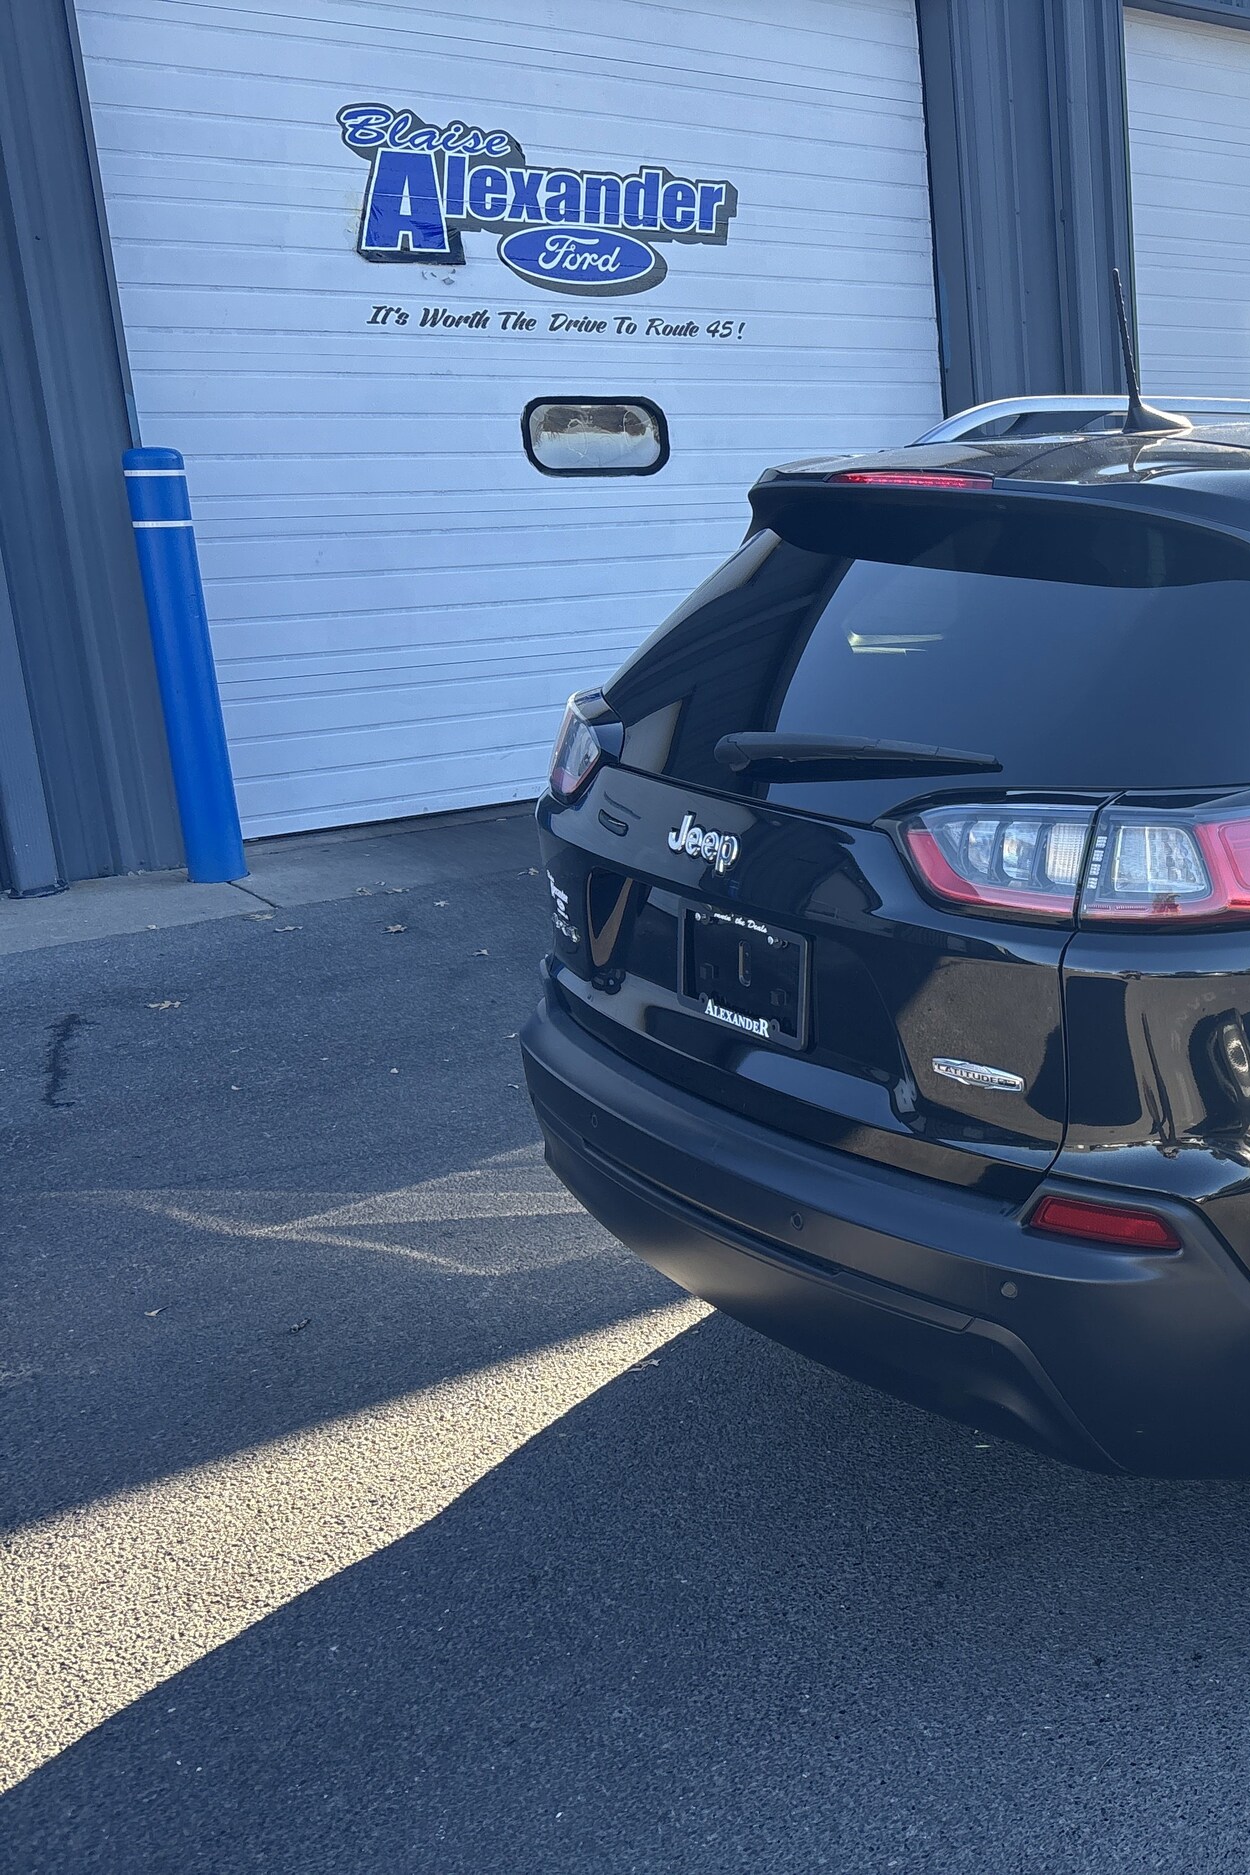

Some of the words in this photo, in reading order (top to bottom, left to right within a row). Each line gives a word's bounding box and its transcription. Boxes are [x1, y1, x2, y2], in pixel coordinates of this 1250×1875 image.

[341, 107, 512, 157] Blaise
[362, 147, 727, 253] Alexander
[538, 234, 621, 272] Ford
[366, 304, 410, 326] It's
[419, 307, 491, 330] Worth
[497, 310, 538, 331] The
[548, 312, 608, 334] Drive
[613, 316, 638, 336] To
[645, 317, 700, 338] Route
[668, 811, 740, 875] Jeep
[747, 919, 768, 934] Deals
[937, 1063, 997, 1083] LATITUDE
